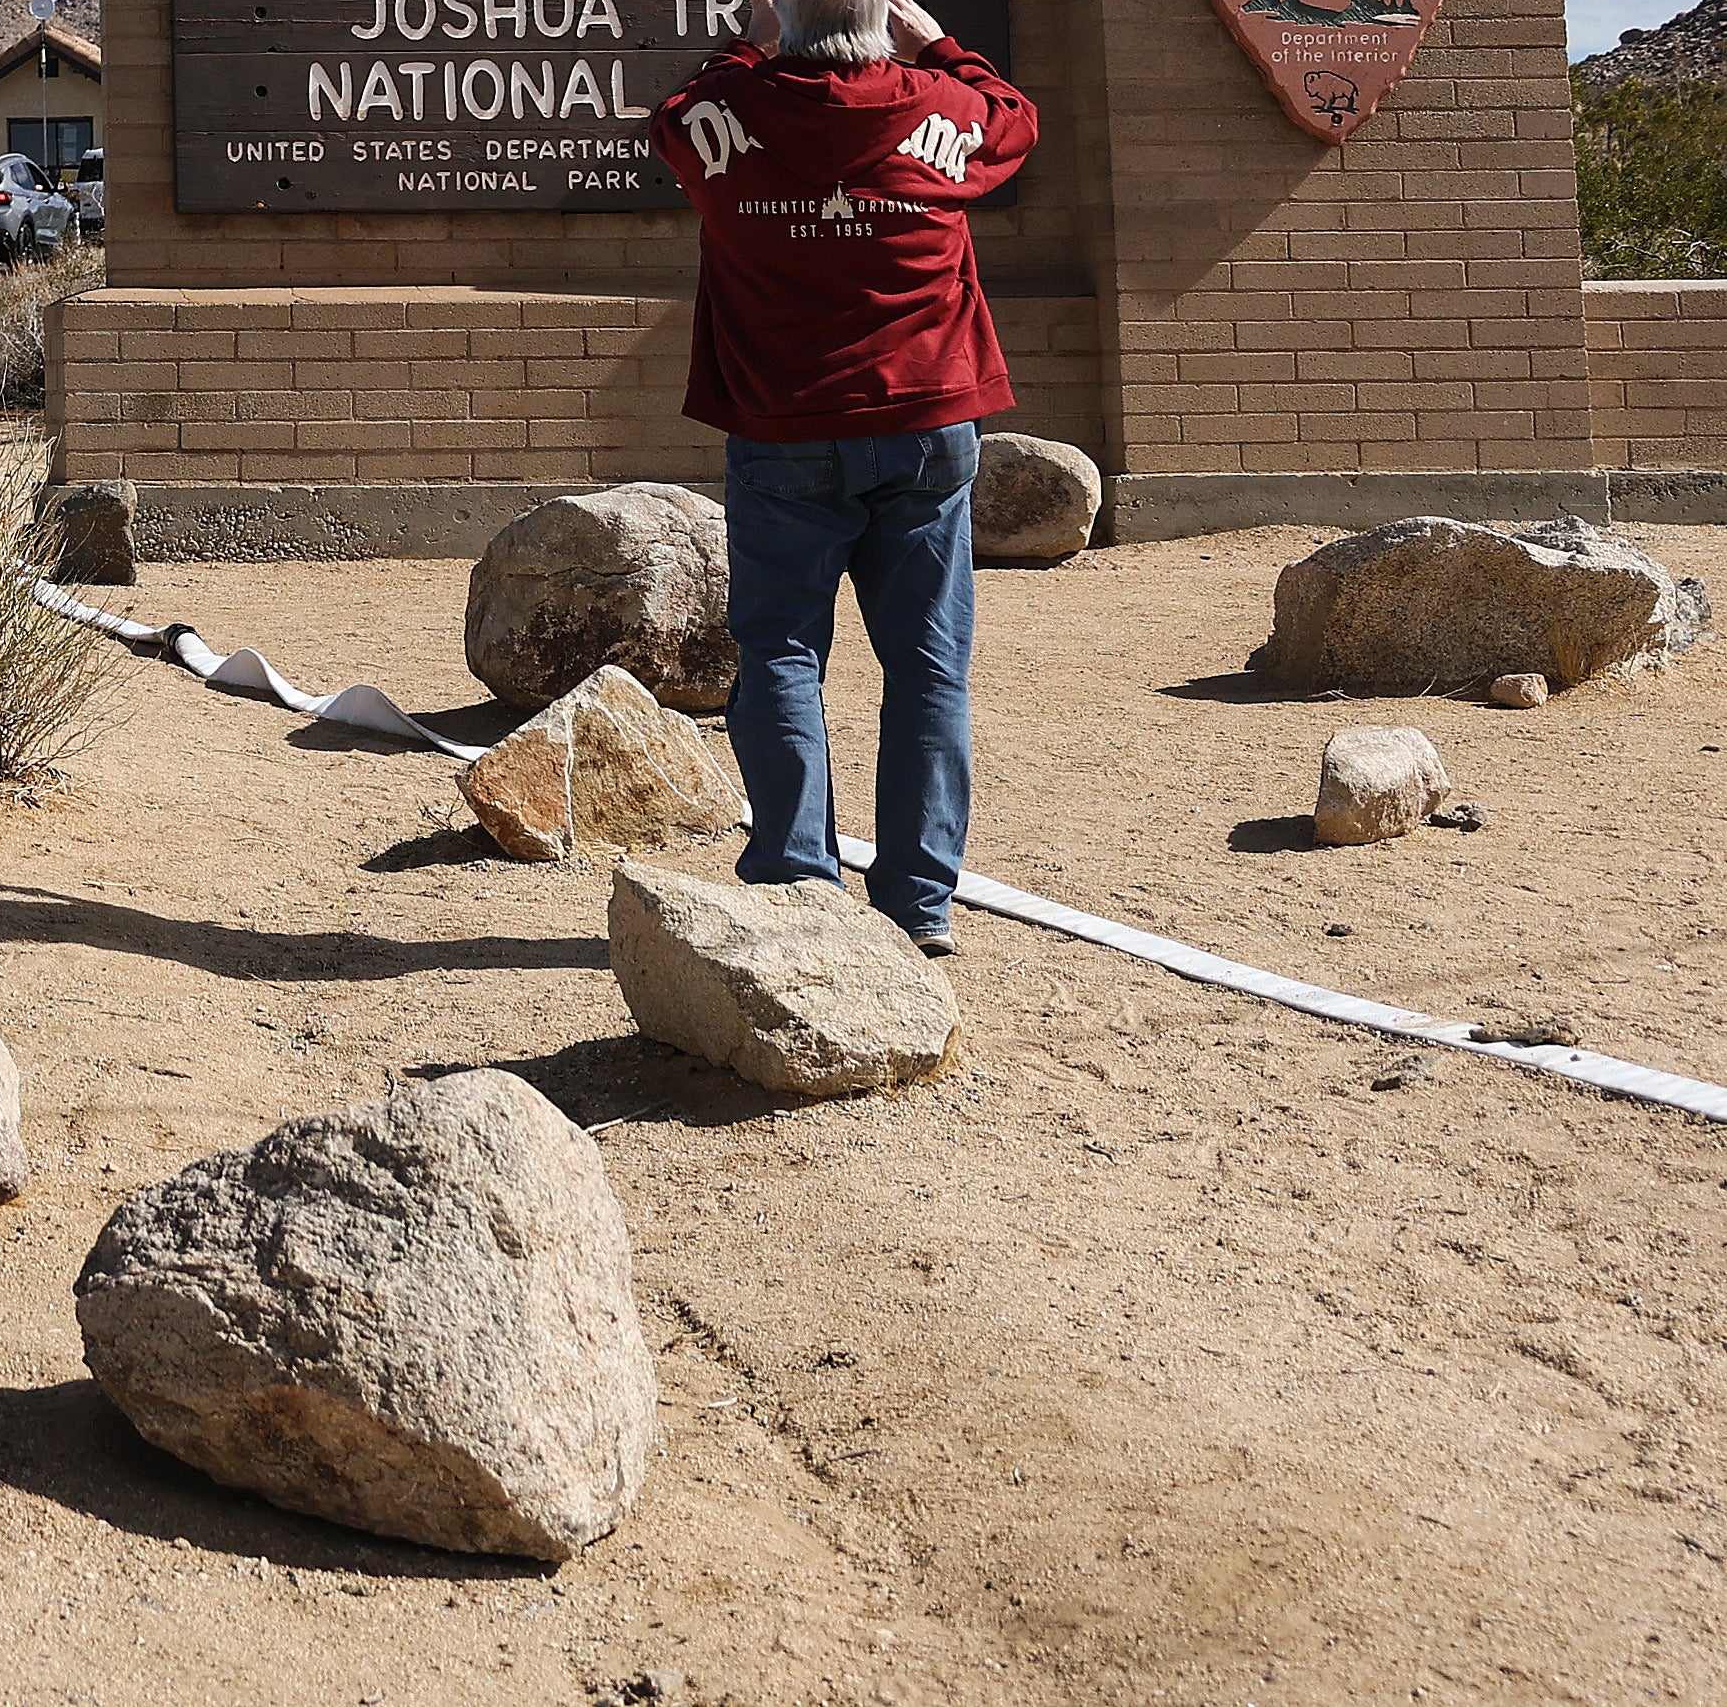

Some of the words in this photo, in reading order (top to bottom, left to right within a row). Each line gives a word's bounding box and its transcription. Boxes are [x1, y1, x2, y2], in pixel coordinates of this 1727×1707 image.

[1280, 30, 1389, 49] Department
[1271, 47, 1290, 63] of
[1295, 47, 1325, 62] the
[1330, 48, 1400, 63] Interior
[308, 58, 652, 122] NATIONAL
[226, 140, 325, 163] UNITED
[352, 139, 453, 162] STATES
[486, 138, 650, 161] DEPARTMEN
[398, 169, 538, 192] NATIONAL
[567, 169, 641, 190] PARK
[738, 200, 816, 214] AUTHENTIC
[790, 224, 825, 238] EST.
[835, 223, 873, 237] 1955
